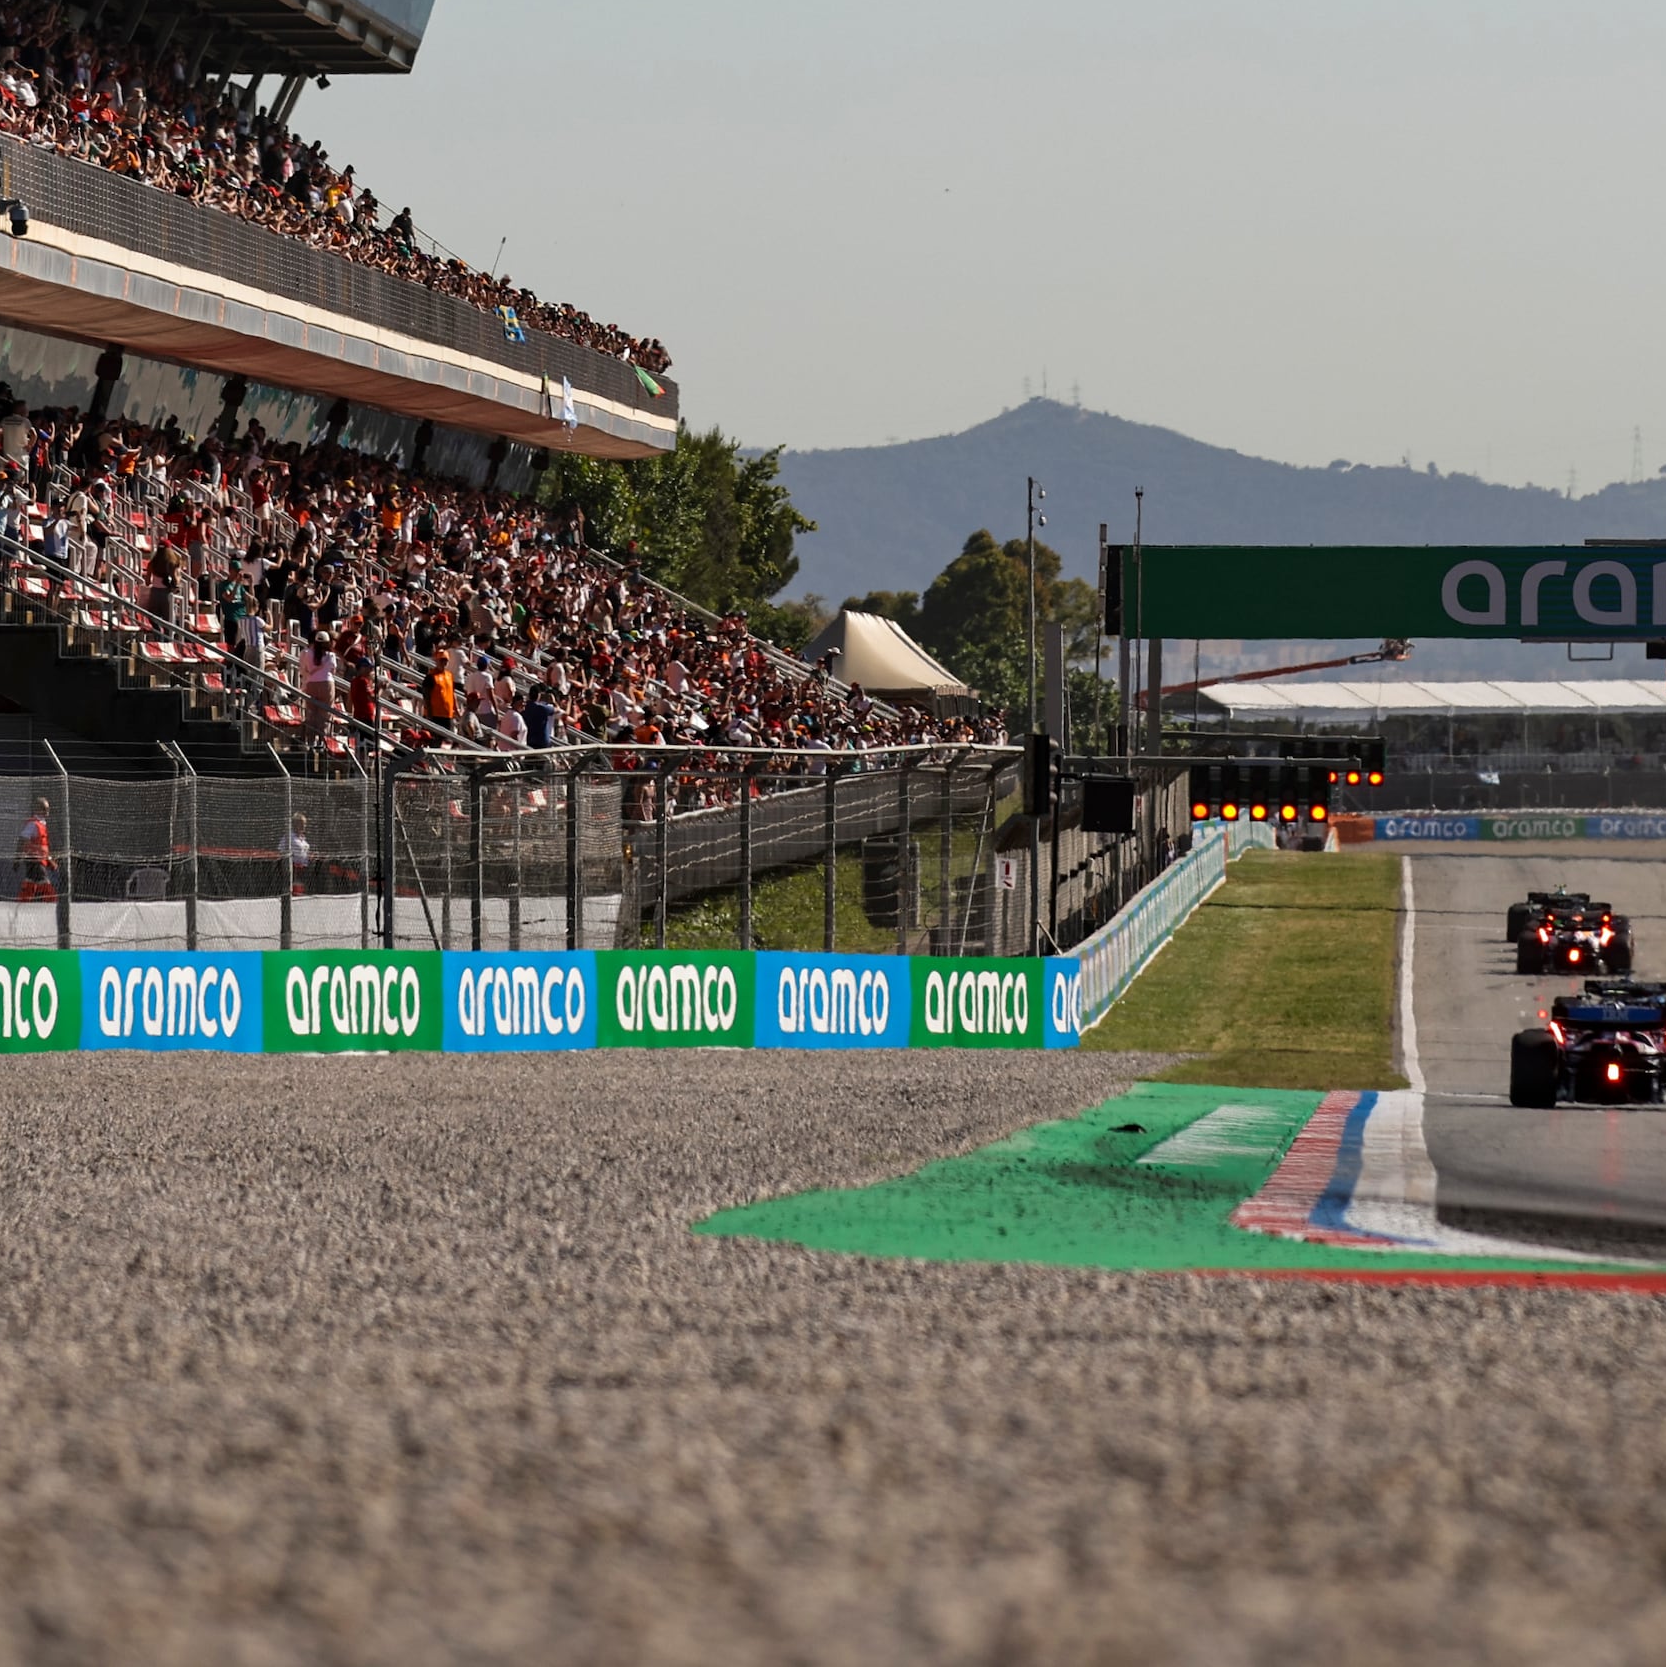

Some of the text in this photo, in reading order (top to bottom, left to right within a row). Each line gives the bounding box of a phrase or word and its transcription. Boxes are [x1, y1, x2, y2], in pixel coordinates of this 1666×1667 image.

[1385, 818, 1467, 837] aramco
[1493, 818, 1576, 837] aramco
[99, 965, 241, 1037] aramco
[286, 964, 420, 1037] aramco
[458, 966, 585, 1036] aramco
[616, 964, 737, 1032] aramco
[778, 967, 889, 1036] aramco
[925, 970, 1028, 1034] aramco
